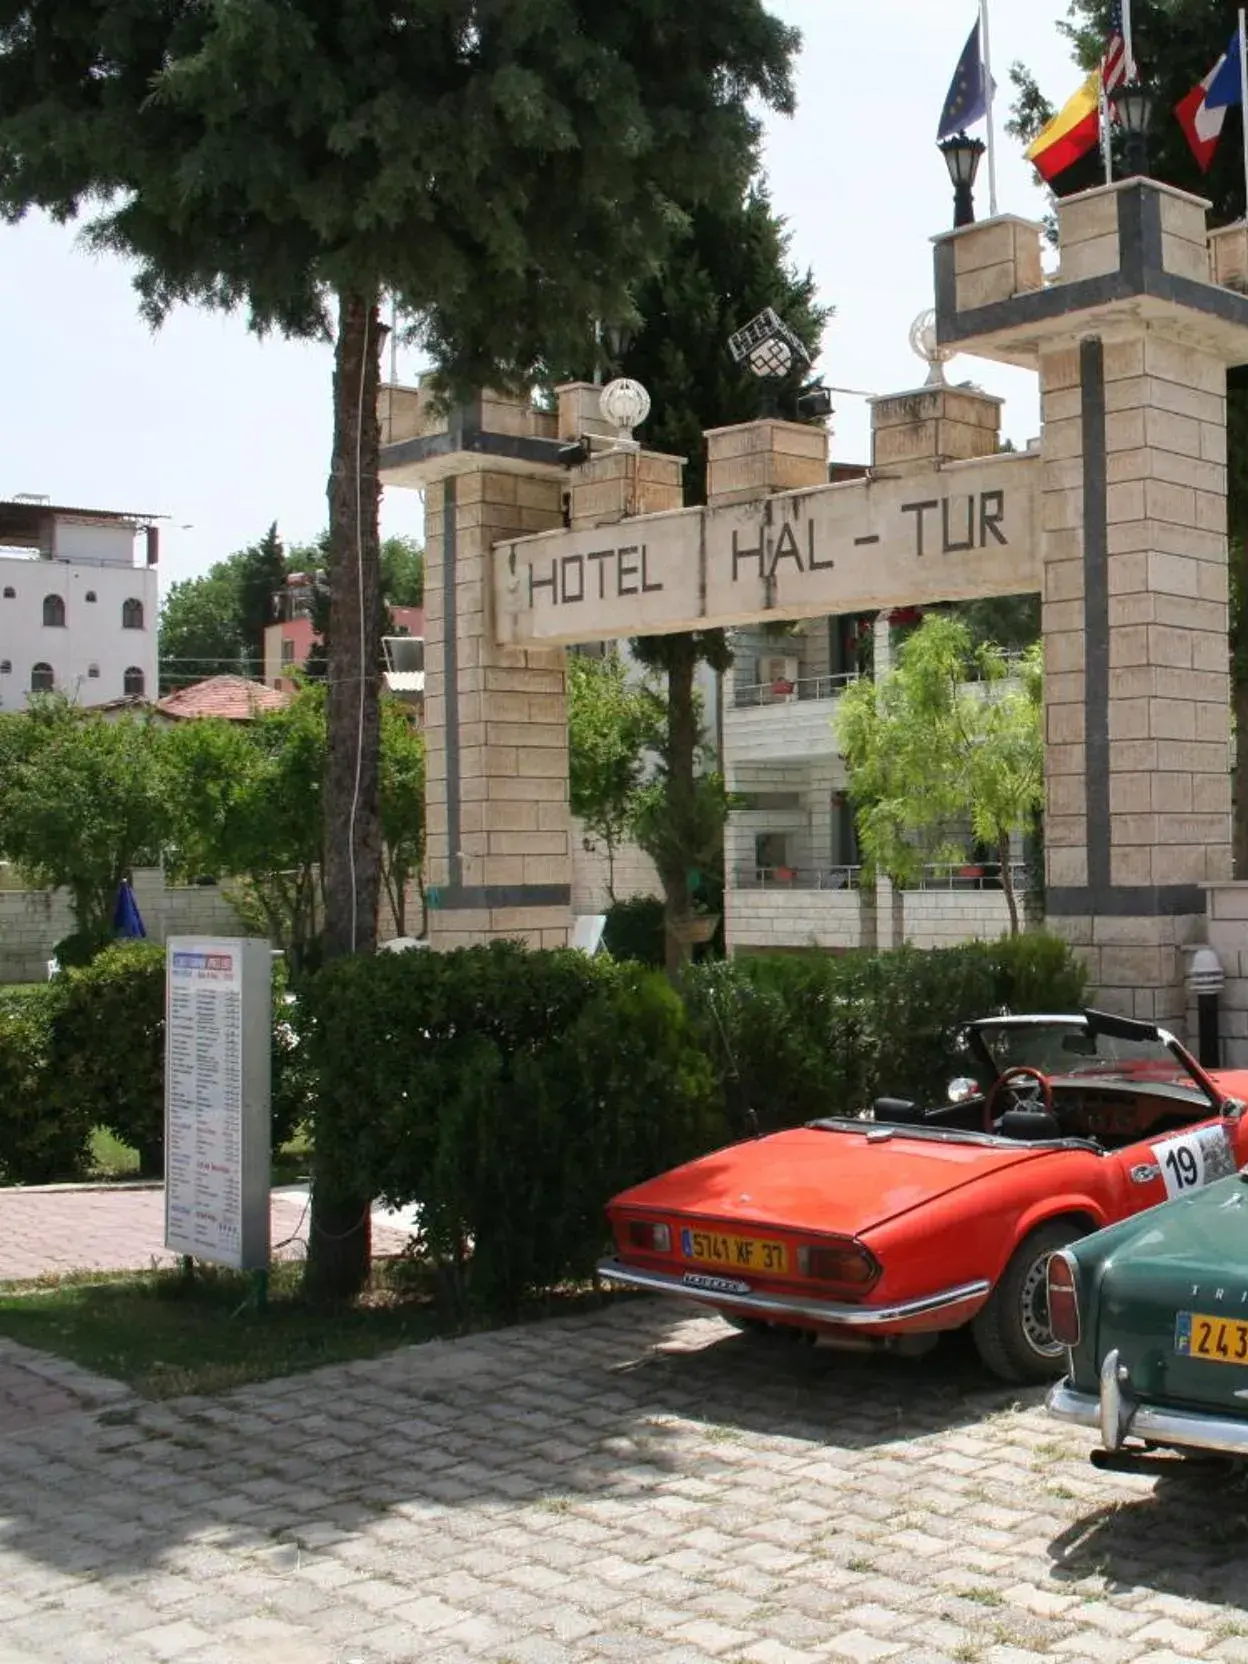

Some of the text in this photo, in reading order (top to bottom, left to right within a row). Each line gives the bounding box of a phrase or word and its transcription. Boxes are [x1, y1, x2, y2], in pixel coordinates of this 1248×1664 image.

[528, 490, 1008, 608] HOTEL HAL - TUR
[1166, 1146, 1198, 1189] 19
[693, 1233, 783, 1269] 5741 XF 37
